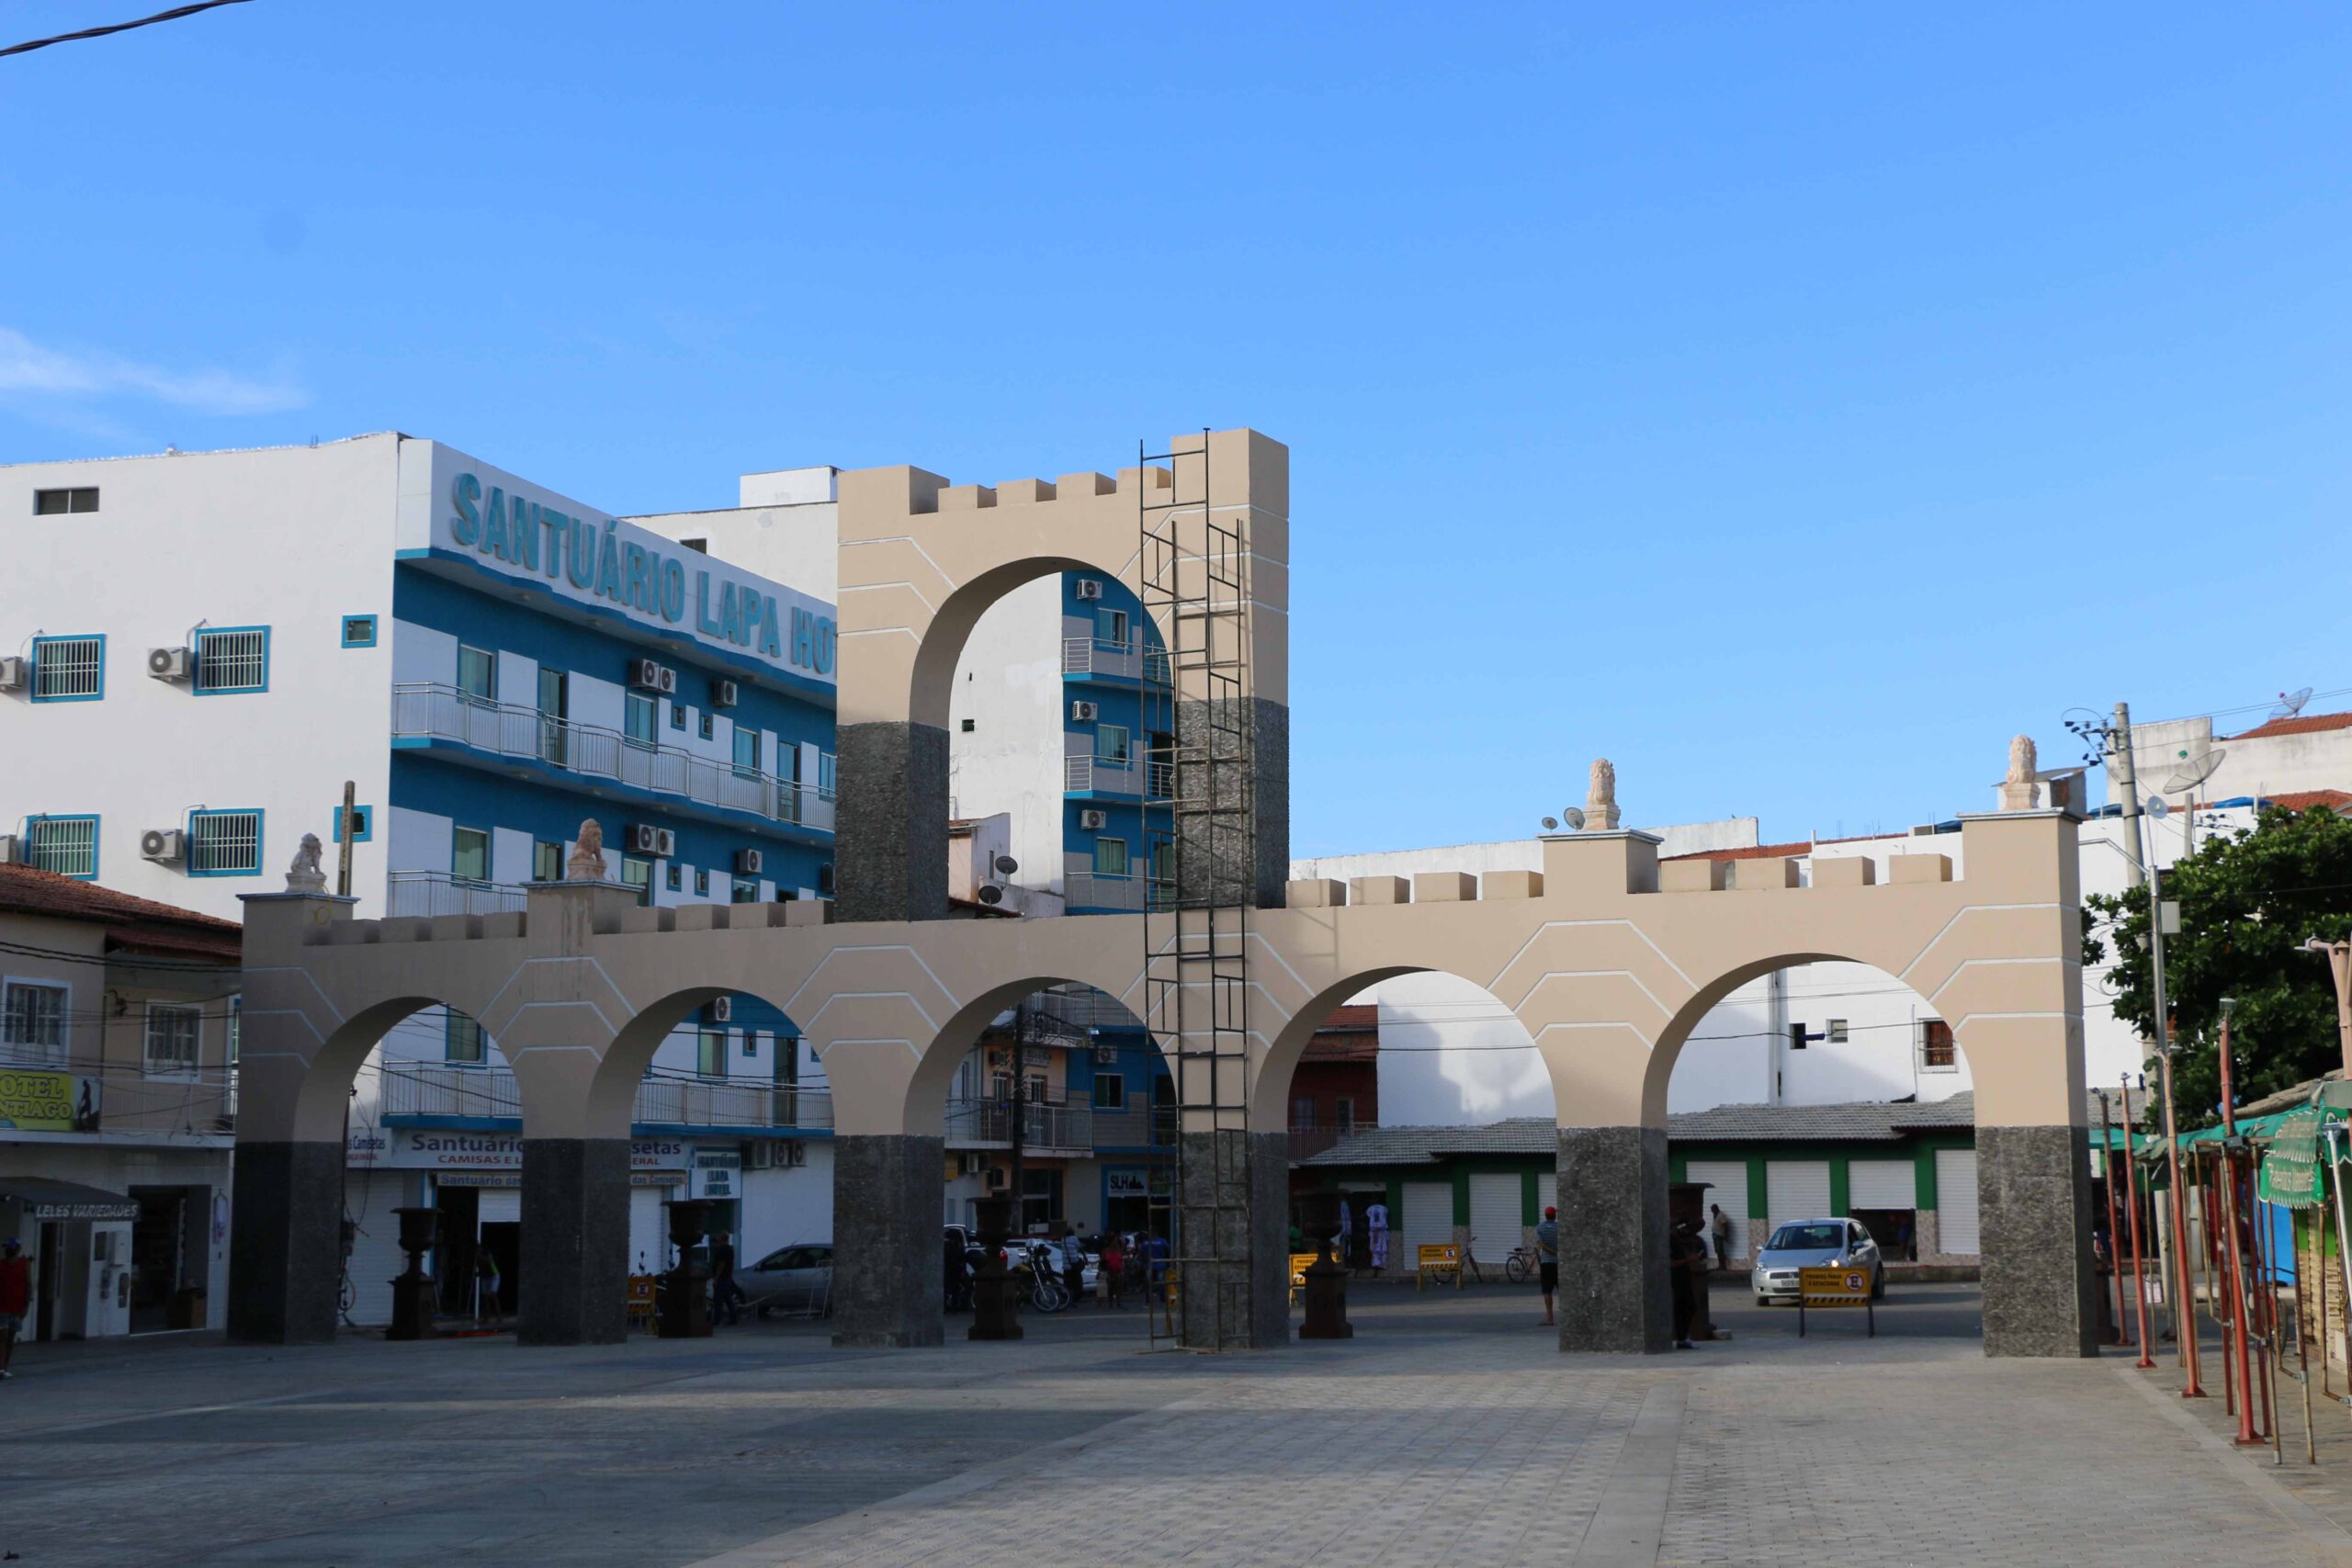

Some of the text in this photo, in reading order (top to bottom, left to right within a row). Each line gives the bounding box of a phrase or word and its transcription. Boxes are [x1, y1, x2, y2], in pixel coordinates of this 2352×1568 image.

[451, 474, 837, 679] SANTUÁRIO LAPA HO
[0, 1074, 64, 1100] OTEL
[437, 1154, 501, 1165] CAMISAS
[503, 1156, 513, 1165] E
[73, 1204, 139, 1217] VARIEDADES
